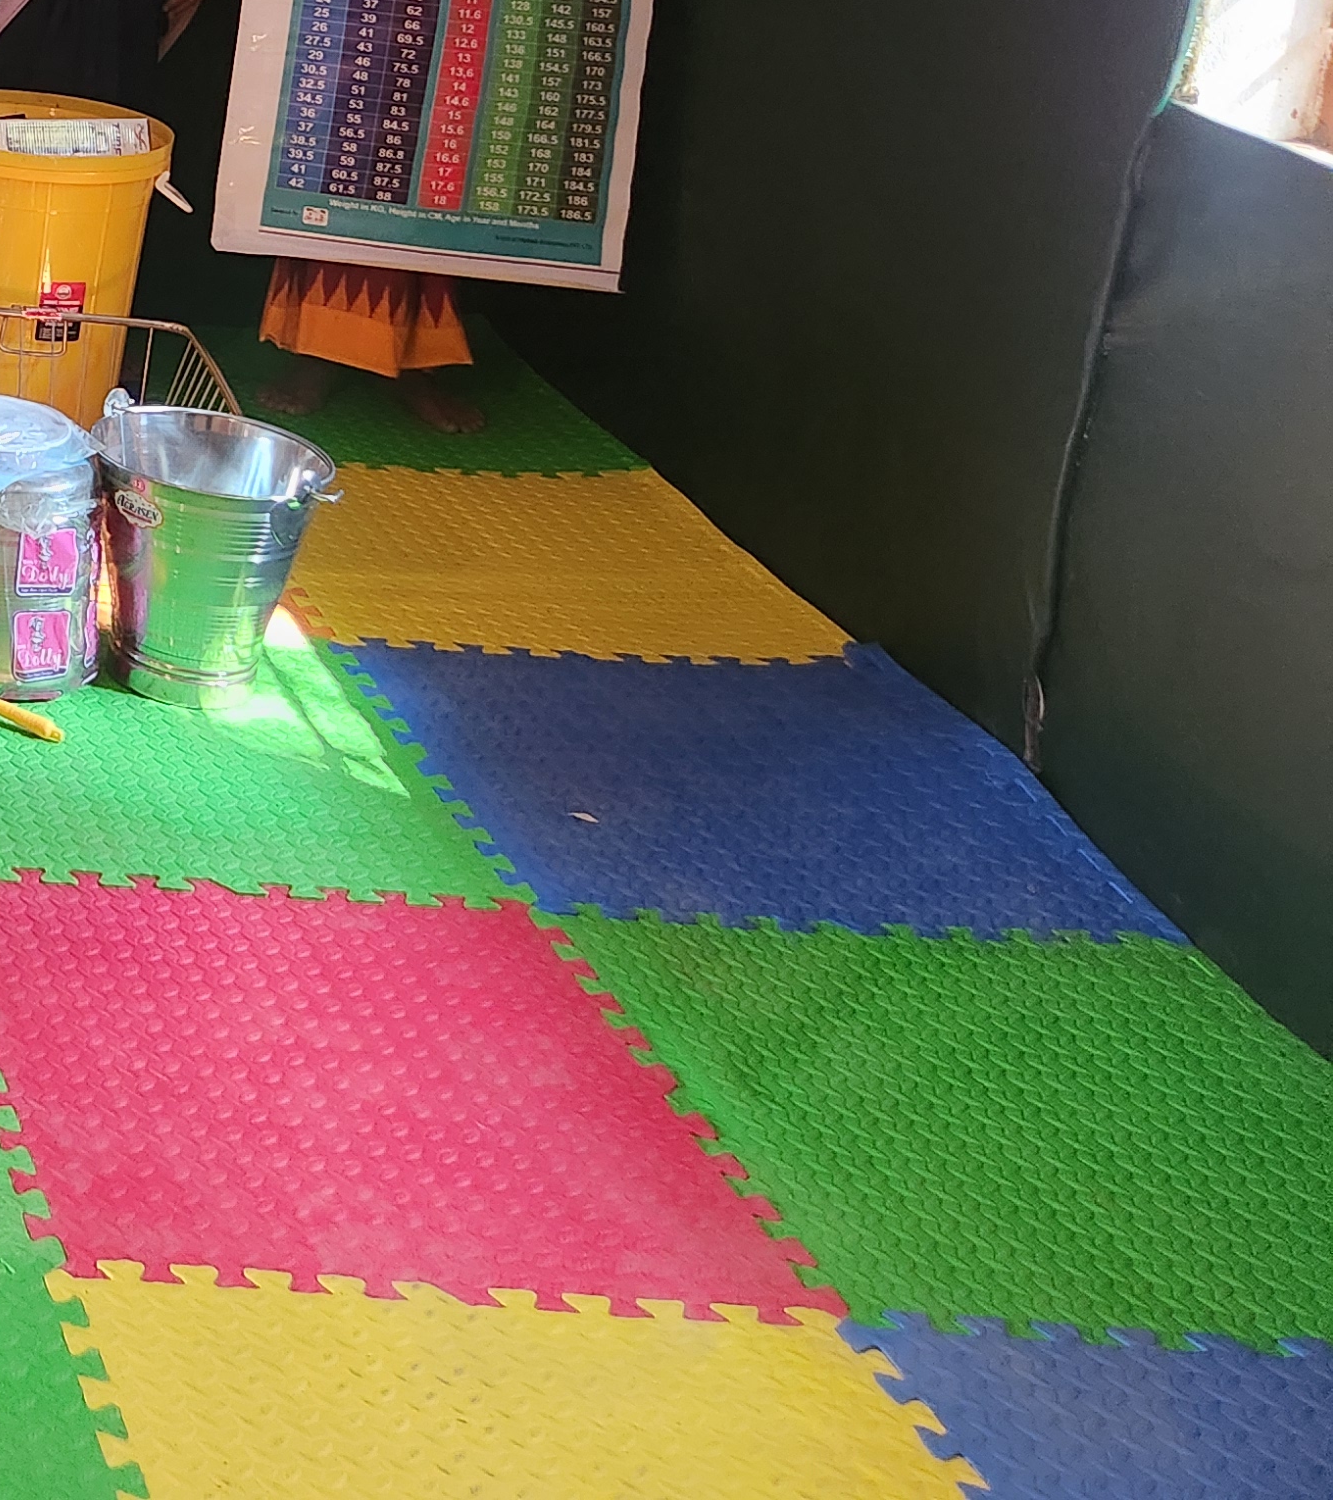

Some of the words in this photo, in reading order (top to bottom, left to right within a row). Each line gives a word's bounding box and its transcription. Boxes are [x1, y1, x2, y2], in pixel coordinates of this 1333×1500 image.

[305, 35, 331, 47] 27.5
[357, 42, 372, 52] 43
[401, 49, 416, 59] 72
[458, 53, 471, 62] 13
[540, 62, 569, 73] 154.5
[586, 66, 605, 76] 170
[297, 92, 323, 104] 34.5
[349, 99, 364, 109] 53
[390, 106, 405, 116] 83
[448, 110, 461, 120] 15
[573, 123, 602, 134] 179.5
[289, 178, 304, 188] 42
[329, 183, 355, 194] 61.5
[376, 191, 391, 201] 88
[434, 195, 447, 205] 18
[517, 205, 549, 216] 173.5
[561, 210, 591, 221] 186.5
[21, 562, 70, 588] Dolly
[17, 648, 63, 670] Dolly
